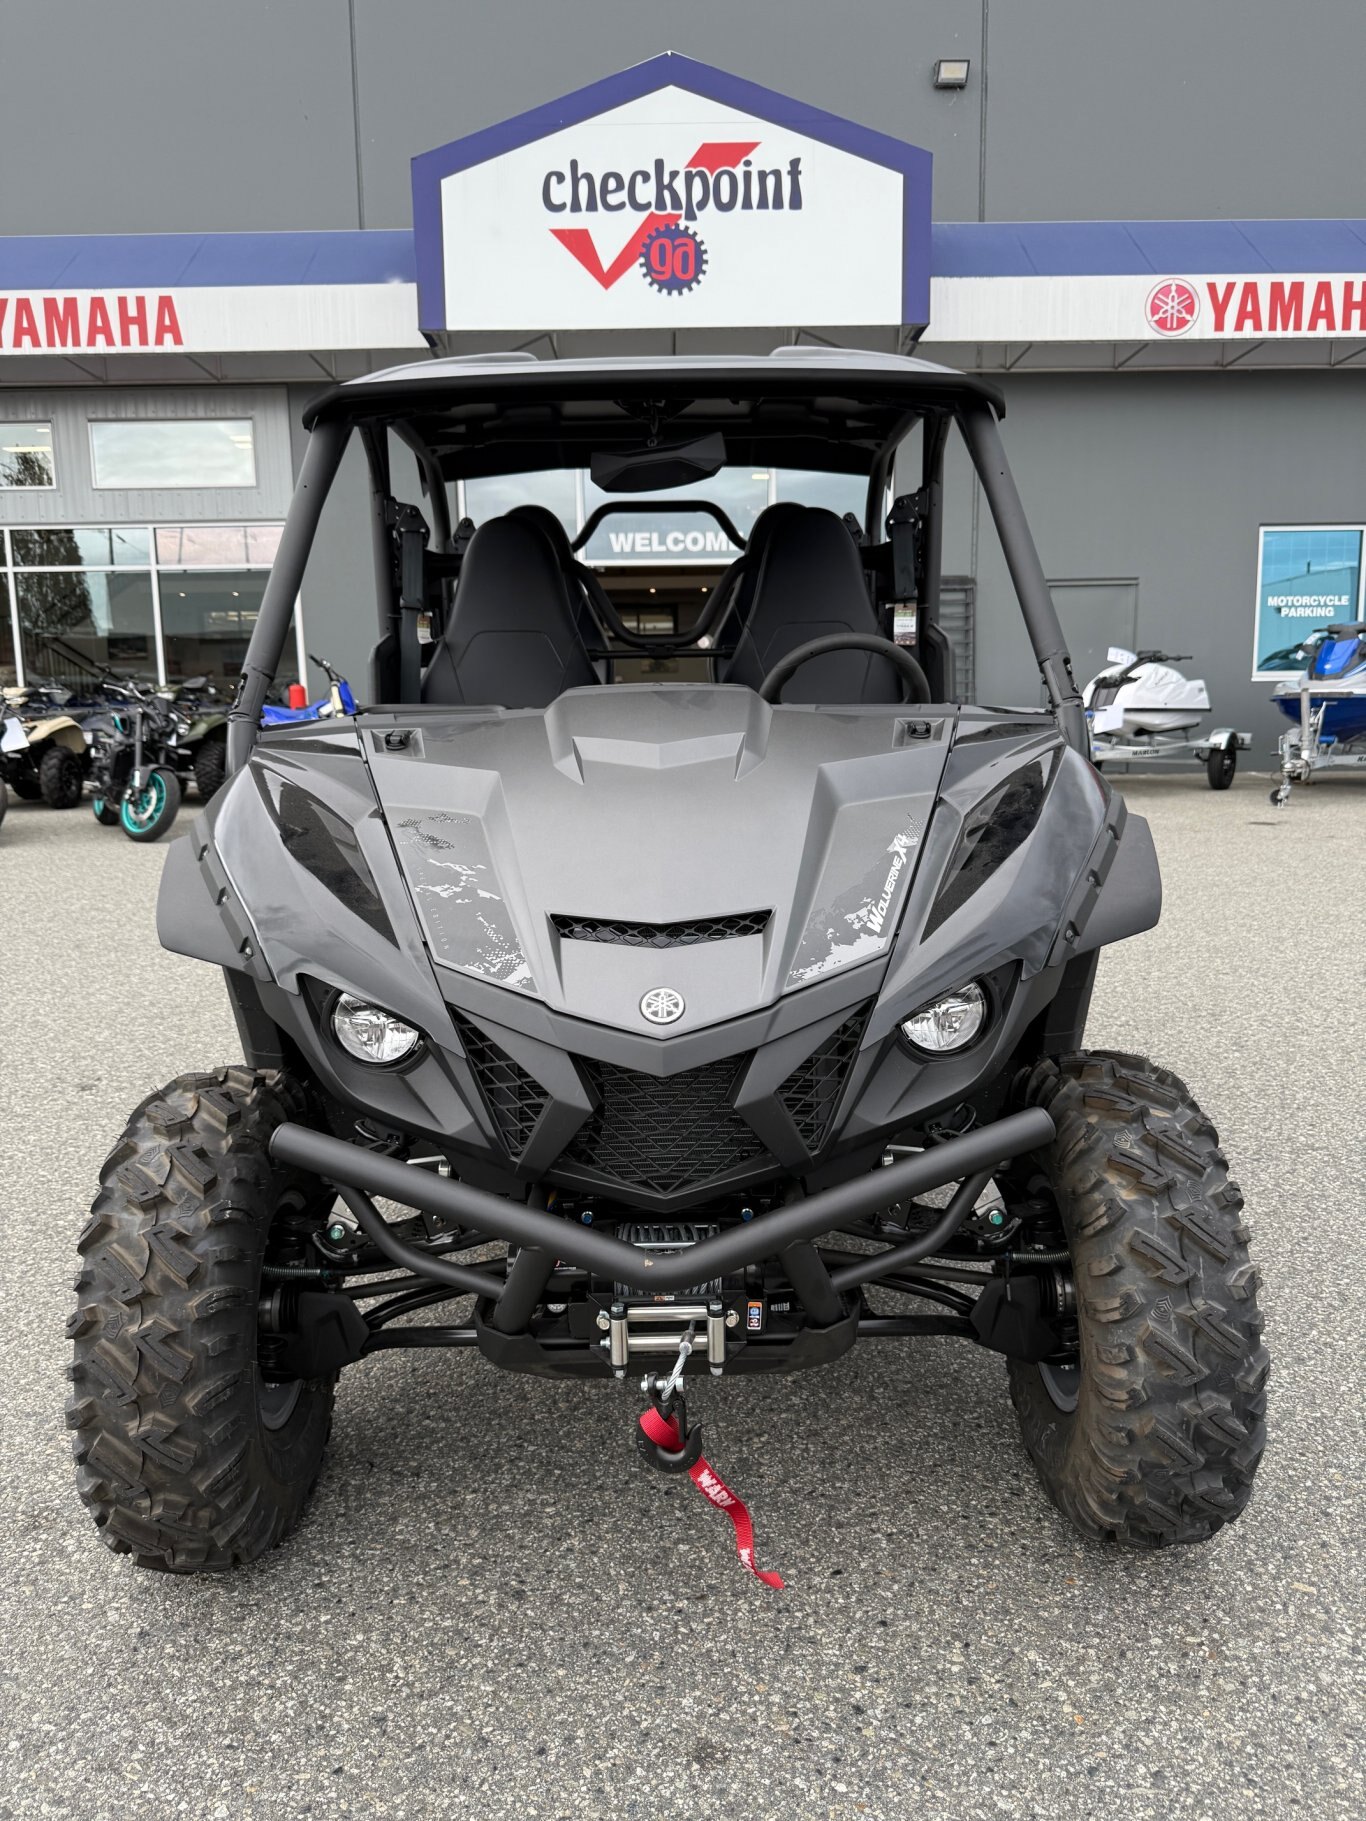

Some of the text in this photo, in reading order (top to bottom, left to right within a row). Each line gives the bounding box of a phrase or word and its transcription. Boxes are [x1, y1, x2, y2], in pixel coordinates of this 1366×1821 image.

[542, 157, 803, 222] checkpoint
[1206, 281, 1366, 332] YAMAH
[1267, 595, 1350, 607] MOTORCYCLE
[1280, 606, 1335, 618] PARKING
[698, 1468, 736, 1507] WARN
